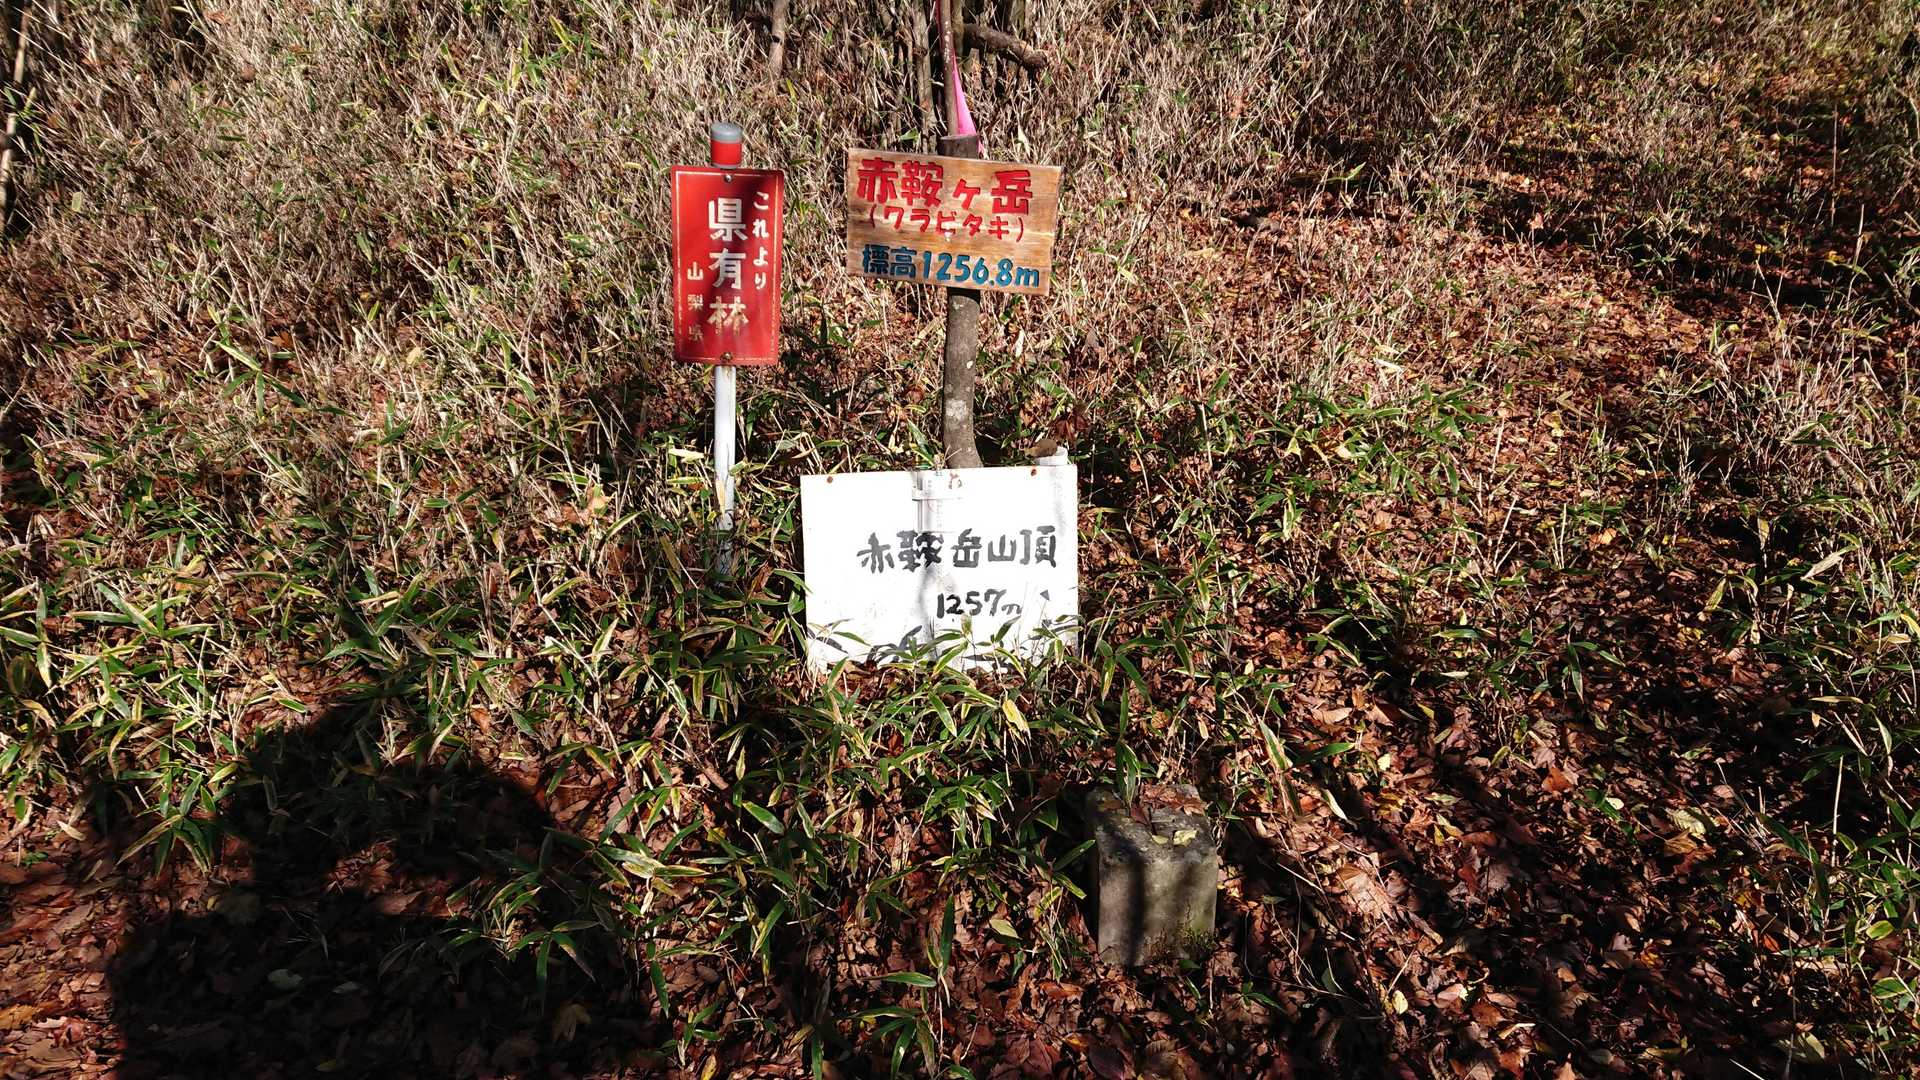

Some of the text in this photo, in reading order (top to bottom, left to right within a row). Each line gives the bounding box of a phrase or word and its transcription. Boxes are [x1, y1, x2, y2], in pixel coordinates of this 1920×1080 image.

[707, 197, 750, 336] 県有林
[752, 191, 770, 290] これより
[862, 244, 1040, 288] 標高1256.8m
[687, 261, 704, 341] 山梨県
[856, 525, 1057, 574] 赤鞍岳山頂
[936, 588, 1023, 619] 1257m
